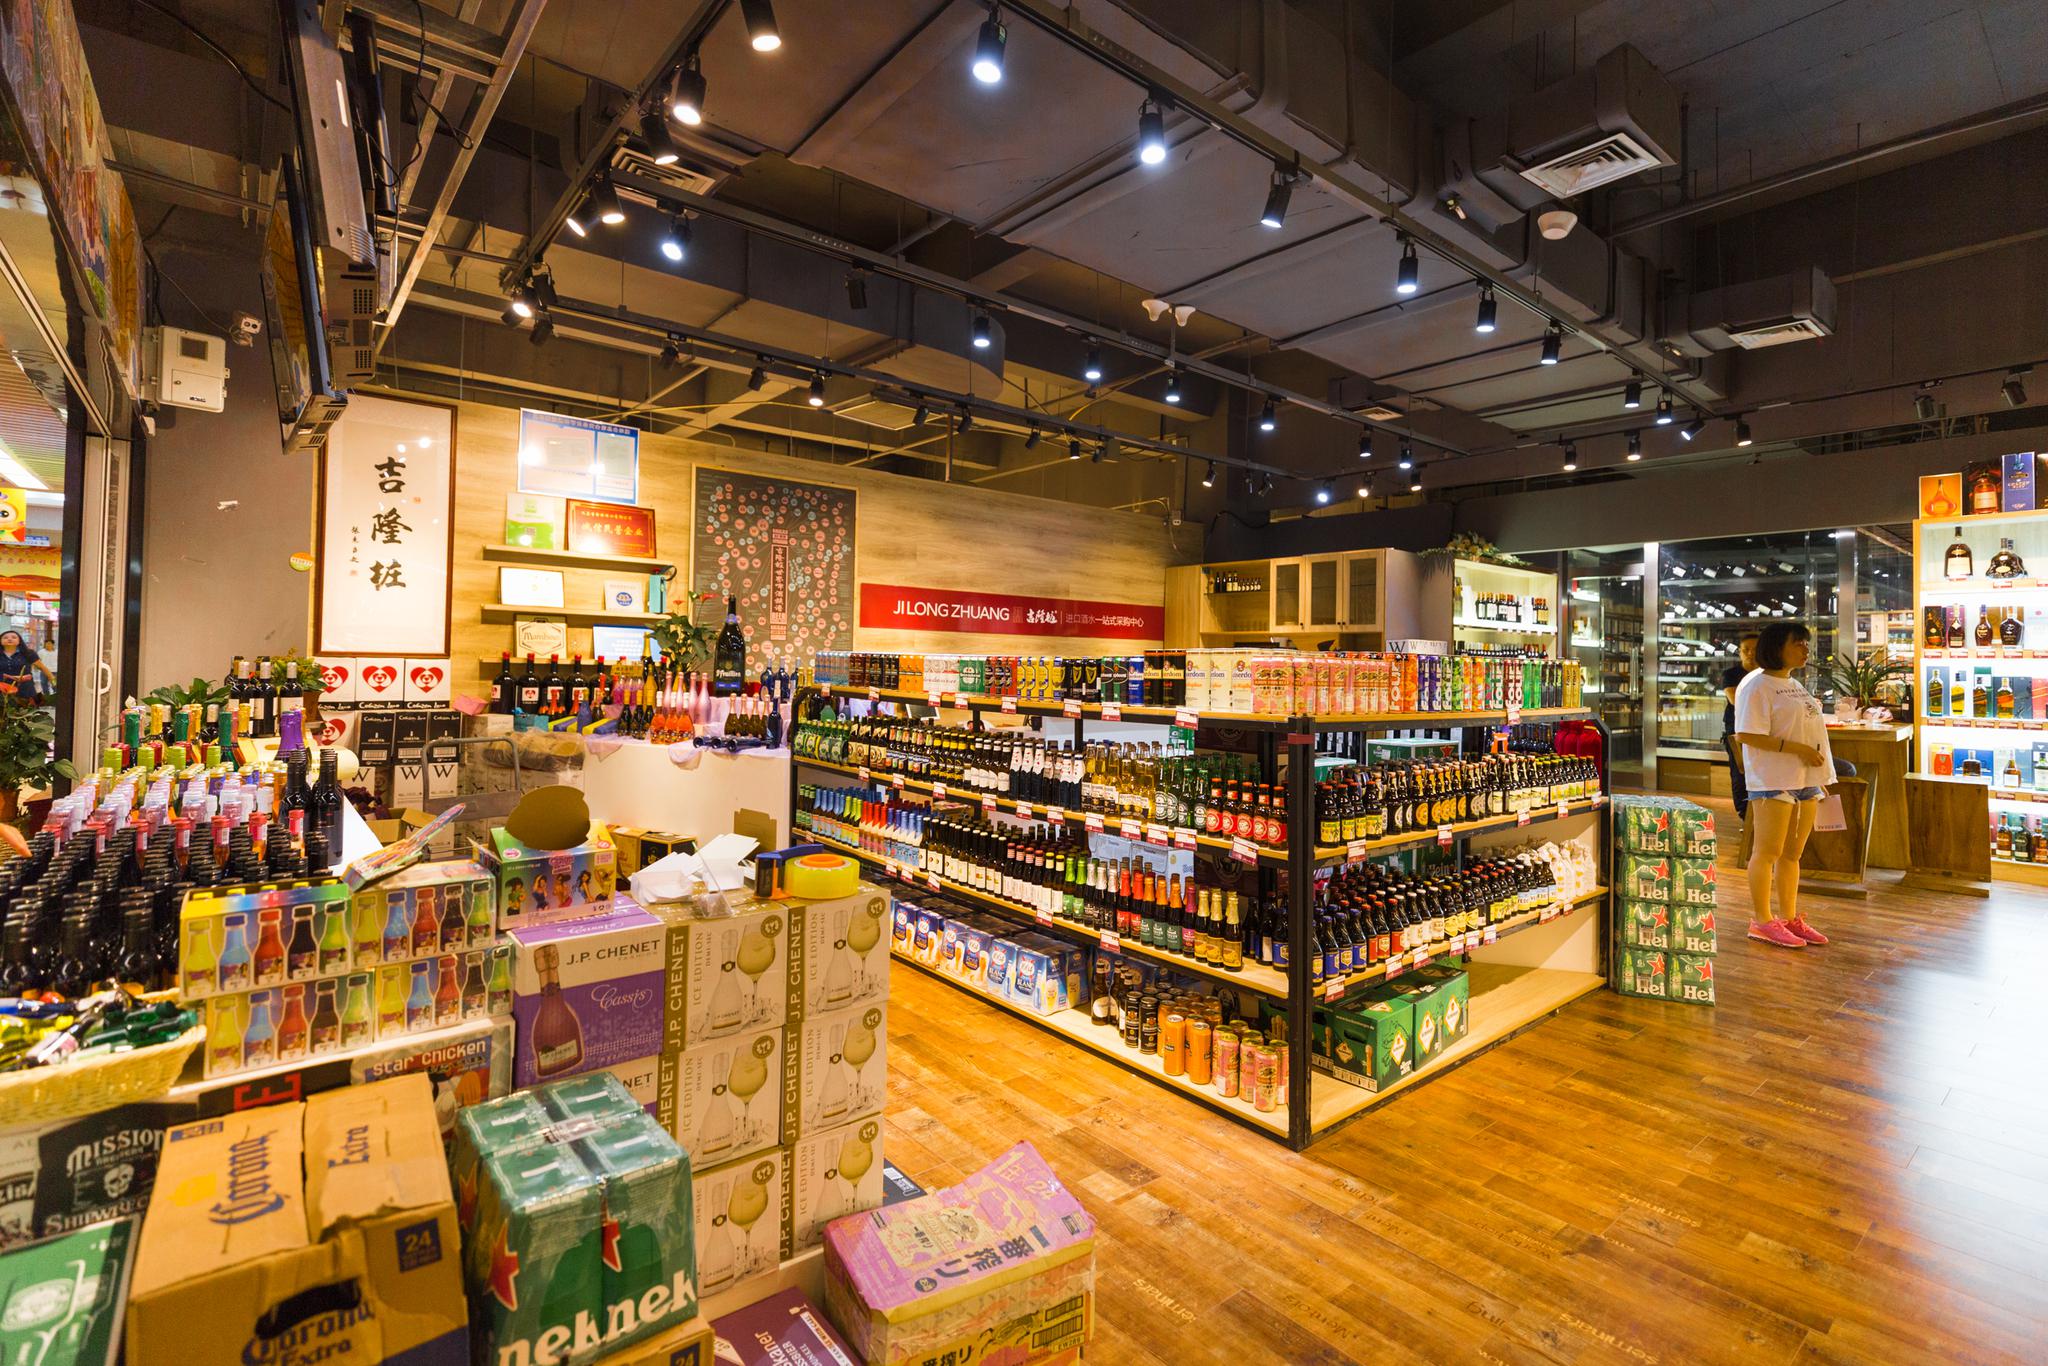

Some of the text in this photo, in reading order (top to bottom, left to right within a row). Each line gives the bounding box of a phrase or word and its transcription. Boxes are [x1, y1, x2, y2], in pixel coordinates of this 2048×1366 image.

[951, 604, 1010, 621] ZHUANG
[401, 766, 422, 780] W
[433, 764, 454, 779] W
[1687, 840, 1717, 856] Hei
[1687, 888, 1717, 905] Hei
[810, 912, 818, 959] EDITION
[1686, 937, 1717, 953] Hei
[566, 939, 661, 965] J.P. CHENET
[694, 931, 703, 984] EDITION
[790, 913, 802, 1019] J.P. CHENET
[591, 984, 653, 1013] Cassis
[669, 933, 684, 1048] J.P. CHENET
[1683, 985, 1715, 1002] Hei
[372, 1056, 414, 1077] star
[806, 1029, 814, 1081] EDITION
[623, 1072, 654, 1088] NET
[683, 1057, 693, 1105] EDITION
[786, 1031, 798, 1138] J.P. CHENET
[327, 1125, 370, 1169] Extra
[208, 1129, 291, 1225] Corona
[800, 1145, 808, 1192] EDITION
[780, 1150, 791, 1257] J.P. CHENET
[404, 1230, 432, 1253] 24
